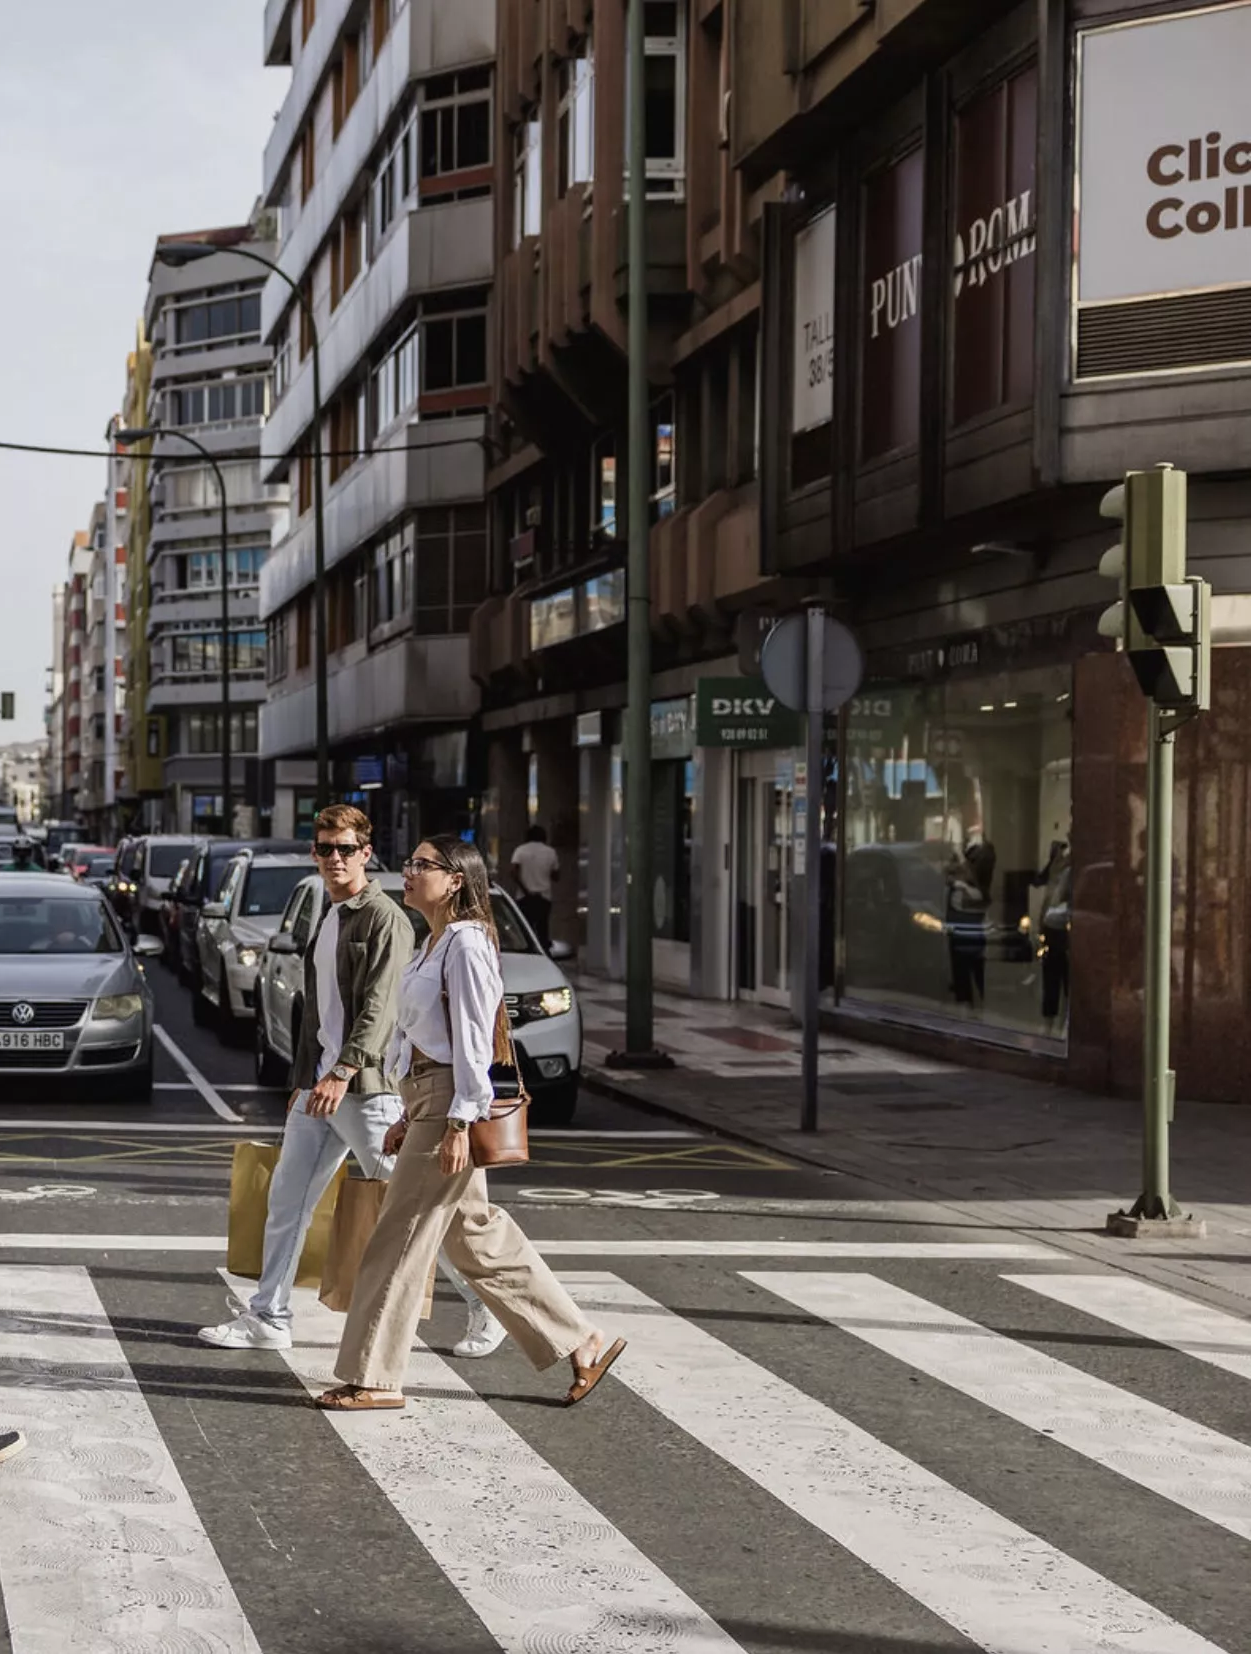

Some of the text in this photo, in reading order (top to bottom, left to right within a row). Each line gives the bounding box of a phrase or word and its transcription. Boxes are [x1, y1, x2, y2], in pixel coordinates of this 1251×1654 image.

[1147, 131, 1251, 187] Clic
[968, 190, 1037, 287] ROM
[712, 698, 775, 716] DKV
[33, 1033, 61, 1048] HBC
